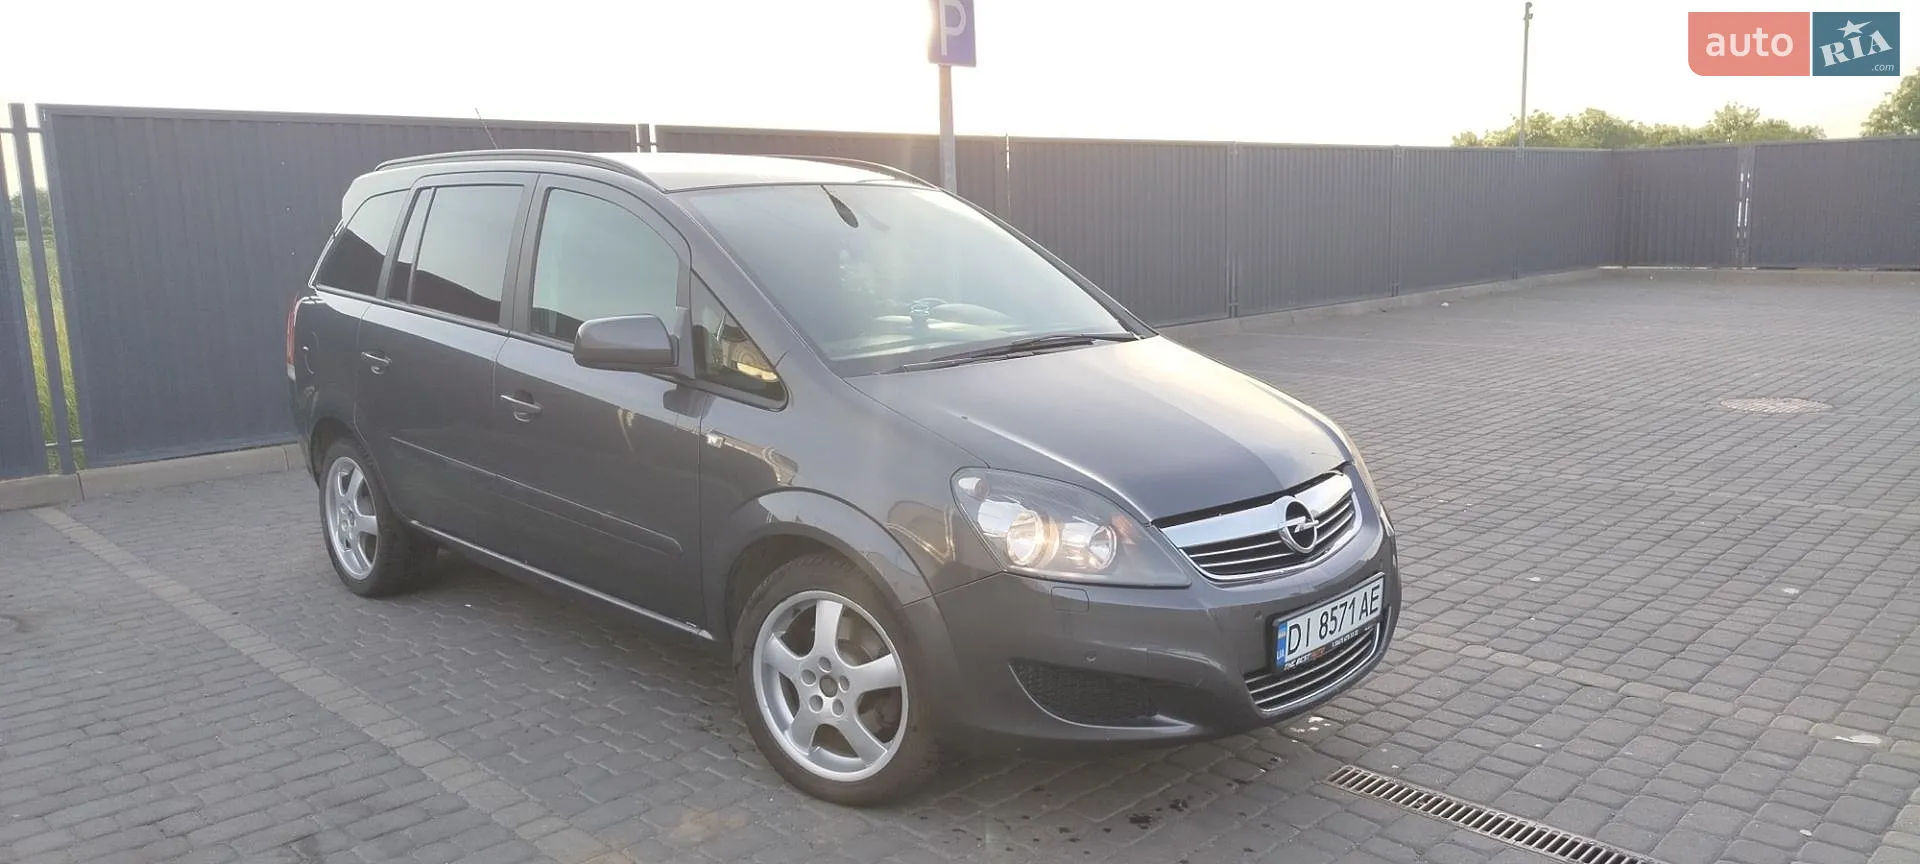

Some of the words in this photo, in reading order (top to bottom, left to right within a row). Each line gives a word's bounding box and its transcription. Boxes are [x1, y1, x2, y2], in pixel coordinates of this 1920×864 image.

[940, 0, 967, 56] P
[1287, 618, 1310, 656] DI
[1318, 597, 1356, 640] 8571
[1359, 585, 1380, 621] AE
